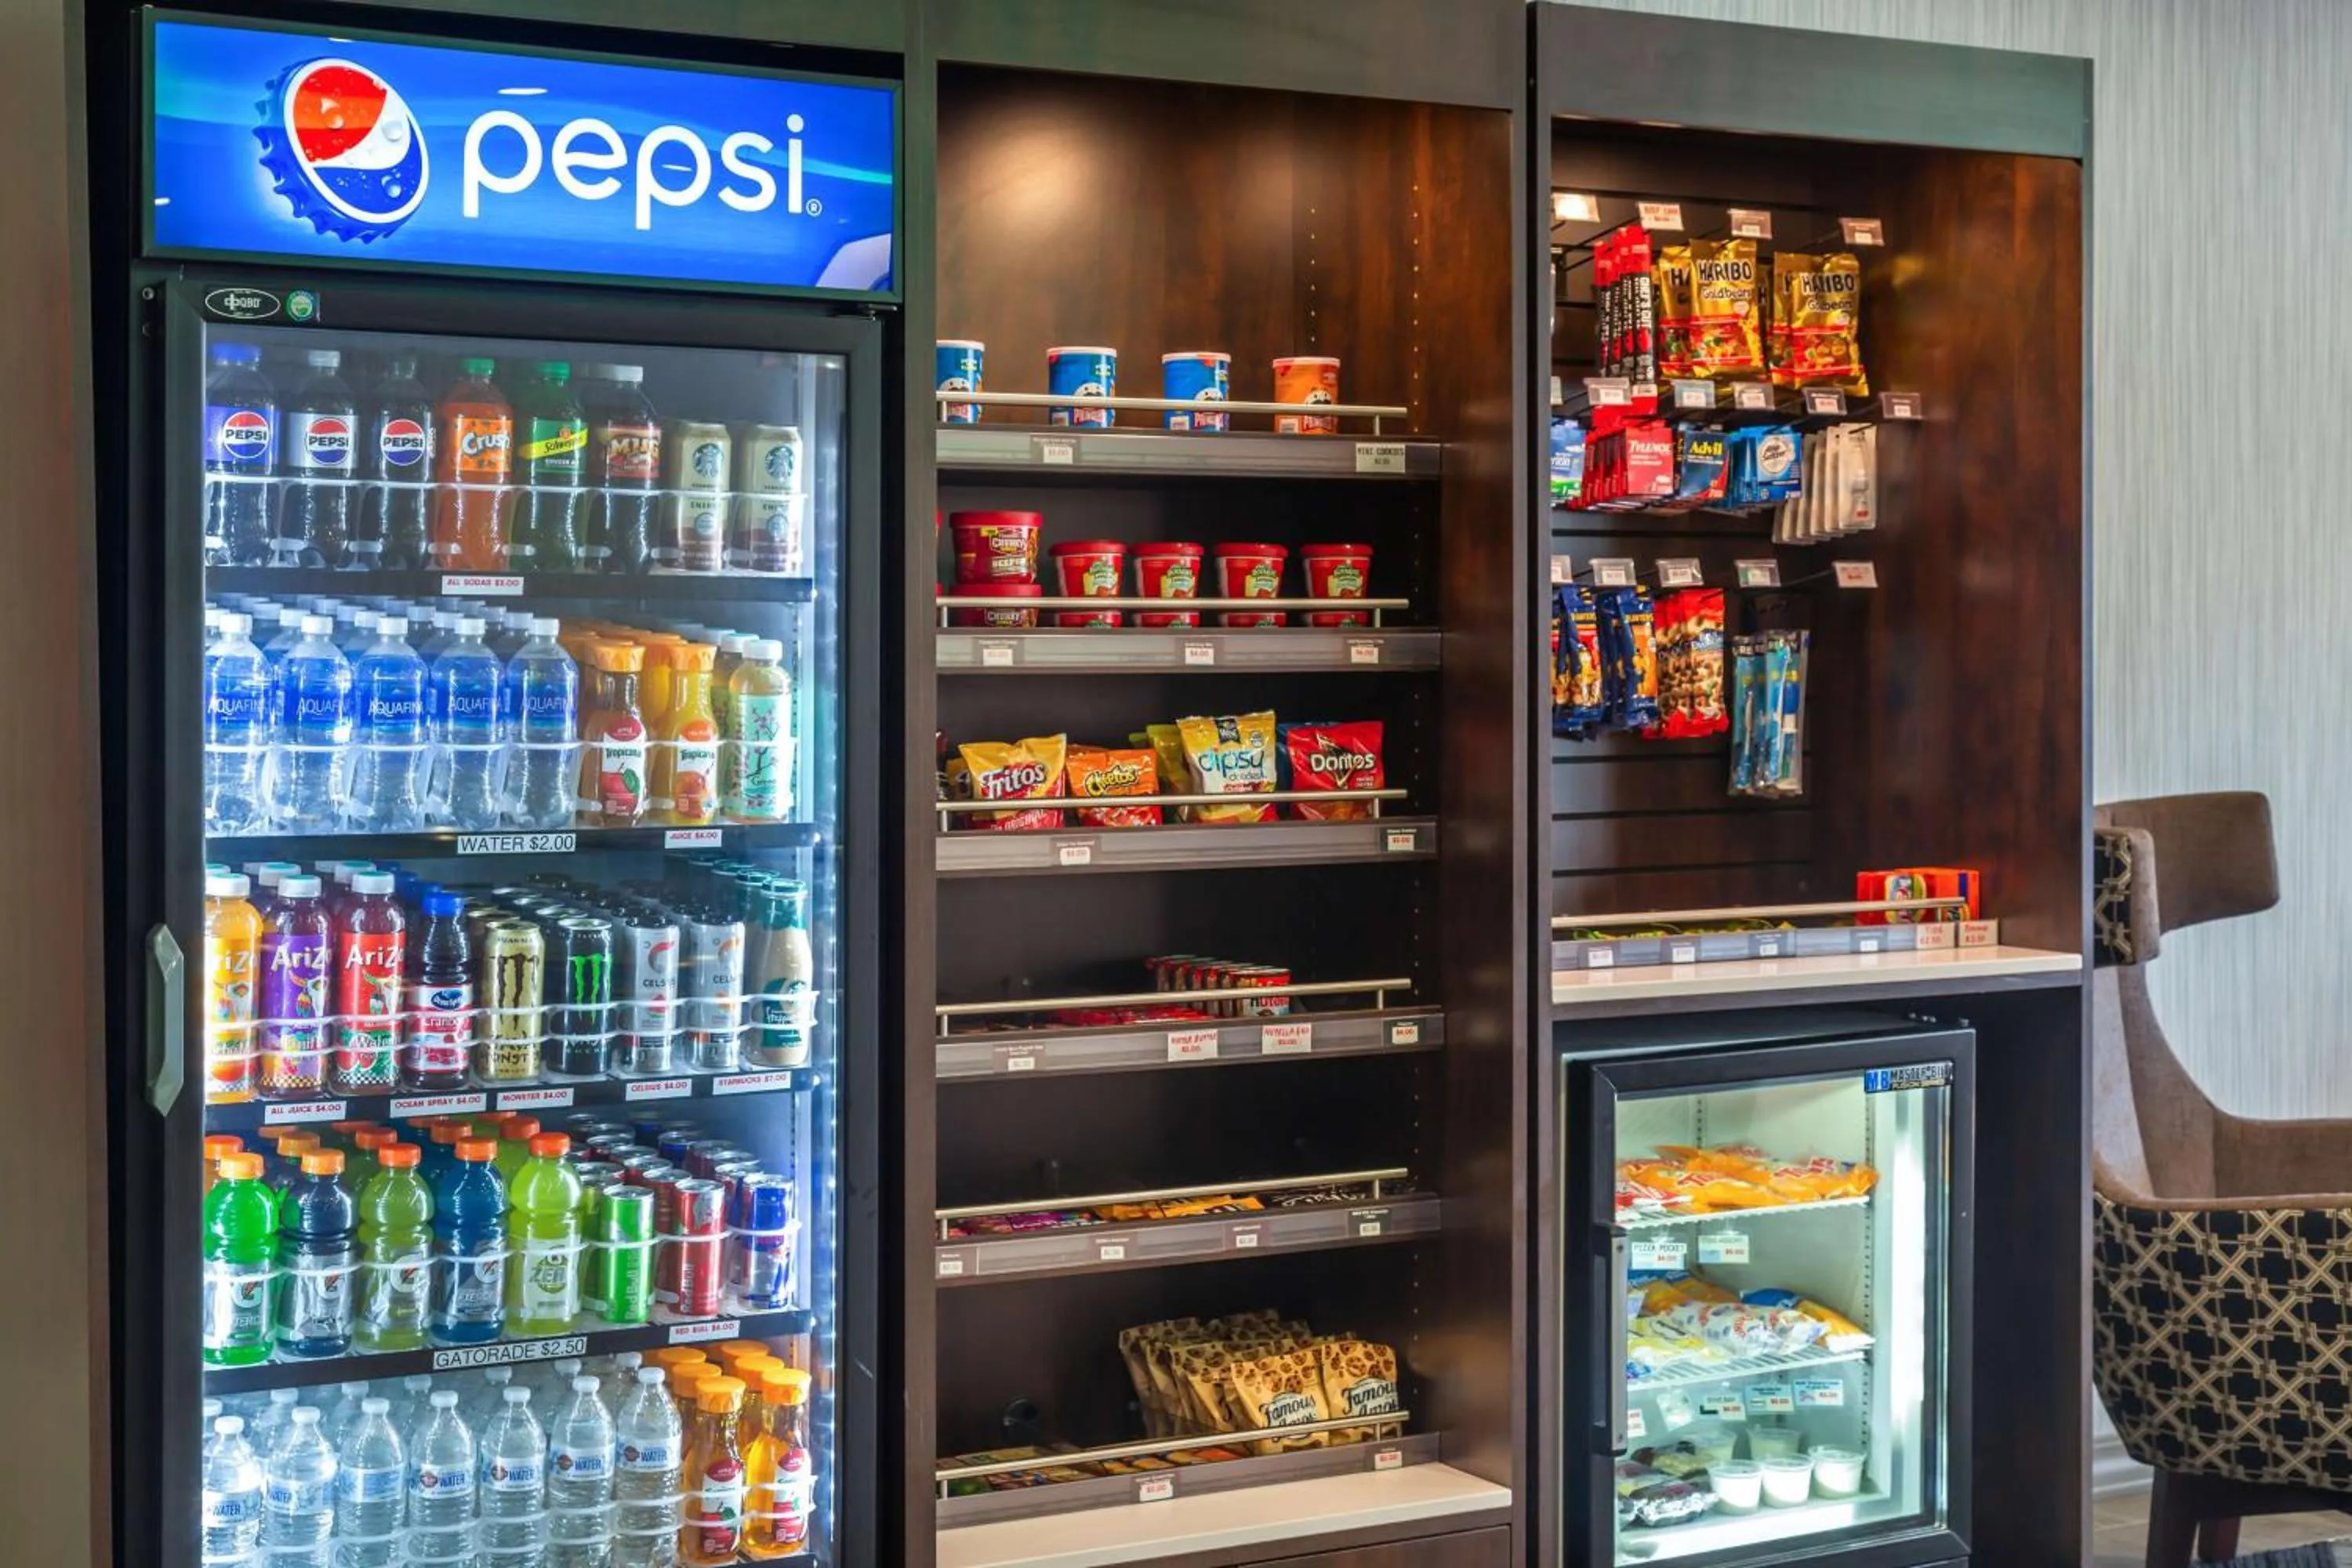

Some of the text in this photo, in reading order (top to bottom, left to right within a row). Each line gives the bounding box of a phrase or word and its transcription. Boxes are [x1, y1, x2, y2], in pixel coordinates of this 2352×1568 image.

[463, 110, 805, 230] pepsi
[1698, 260, 1753, 281] HARIBO
[225, 428, 267, 441] PEPSI
[308, 435, 350, 448] PEPSI
[383, 436, 424, 448] PEPSI
[609, 437, 660, 455] MUG
[1377, 447, 1405, 456] COOKIES
[1630, 440, 1671, 453] TYLENOL
[1690, 441, 1723, 456] Advil
[463, 578, 492, 586] SODAS
[208, 698, 266, 715] AQUAFIN
[605, 746, 642, 760] Tropicana
[1310, 753, 1375, 773] Doritos
[979, 764, 1046, 800] Fritos
[1084, 765, 1138, 797] Cheetos
[460, 835, 575, 852] WATER $2.00
[270, 942, 332, 971] AriZ
[630, 1083, 661, 1092] CELSIUS
[717, 1076, 761, 1087] STARBUCKS
[1867, 1069, 1890, 1091] MB
[394, 1094, 481, 1109] OCEAN SPRAY $4.00
[501, 1090, 568, 1102] MONSTER $4.00
[288, 1105, 313, 1114] JUICE
[314, 1103, 342, 1112] $4.00
[528, 1266, 568, 1284] ZER
[435, 1338, 585, 1368] GATORADE $2.50
[1342, 1382, 1398, 1415] Famou
[1258, 1395, 1316, 1427] Famous
[641, 1450, 667, 1462] WATER
[574, 1459, 602, 1471] WATER
[440, 1473, 466, 1488] WATER
[509, 1468, 536, 1481] WATER
[212, 1504, 241, 1516] WATER
